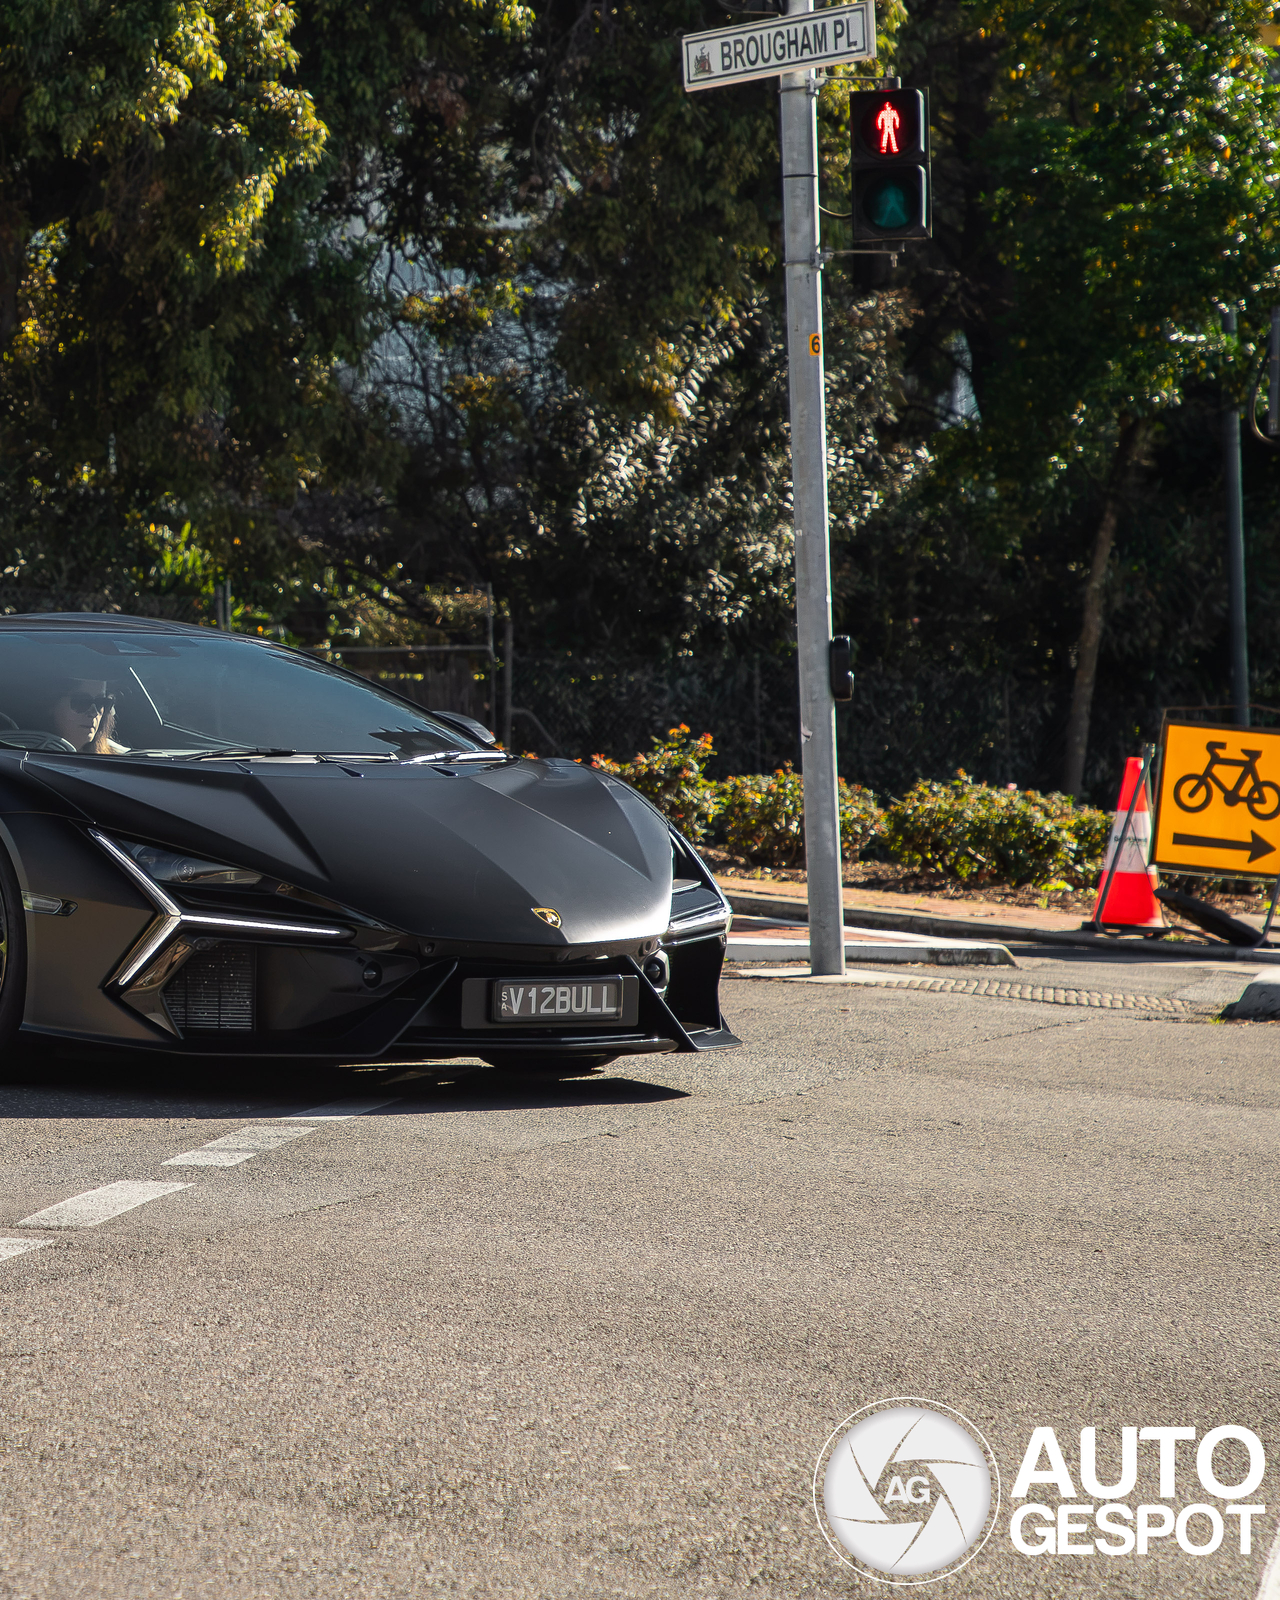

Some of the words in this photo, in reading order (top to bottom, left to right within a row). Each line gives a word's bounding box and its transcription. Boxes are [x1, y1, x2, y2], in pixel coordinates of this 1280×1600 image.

[721, 21, 828, 72] BROUGHAM
[833, 17, 858, 51] PL
[811, 335, 820, 354] 6
[509, 986, 617, 1014] V12BULL
